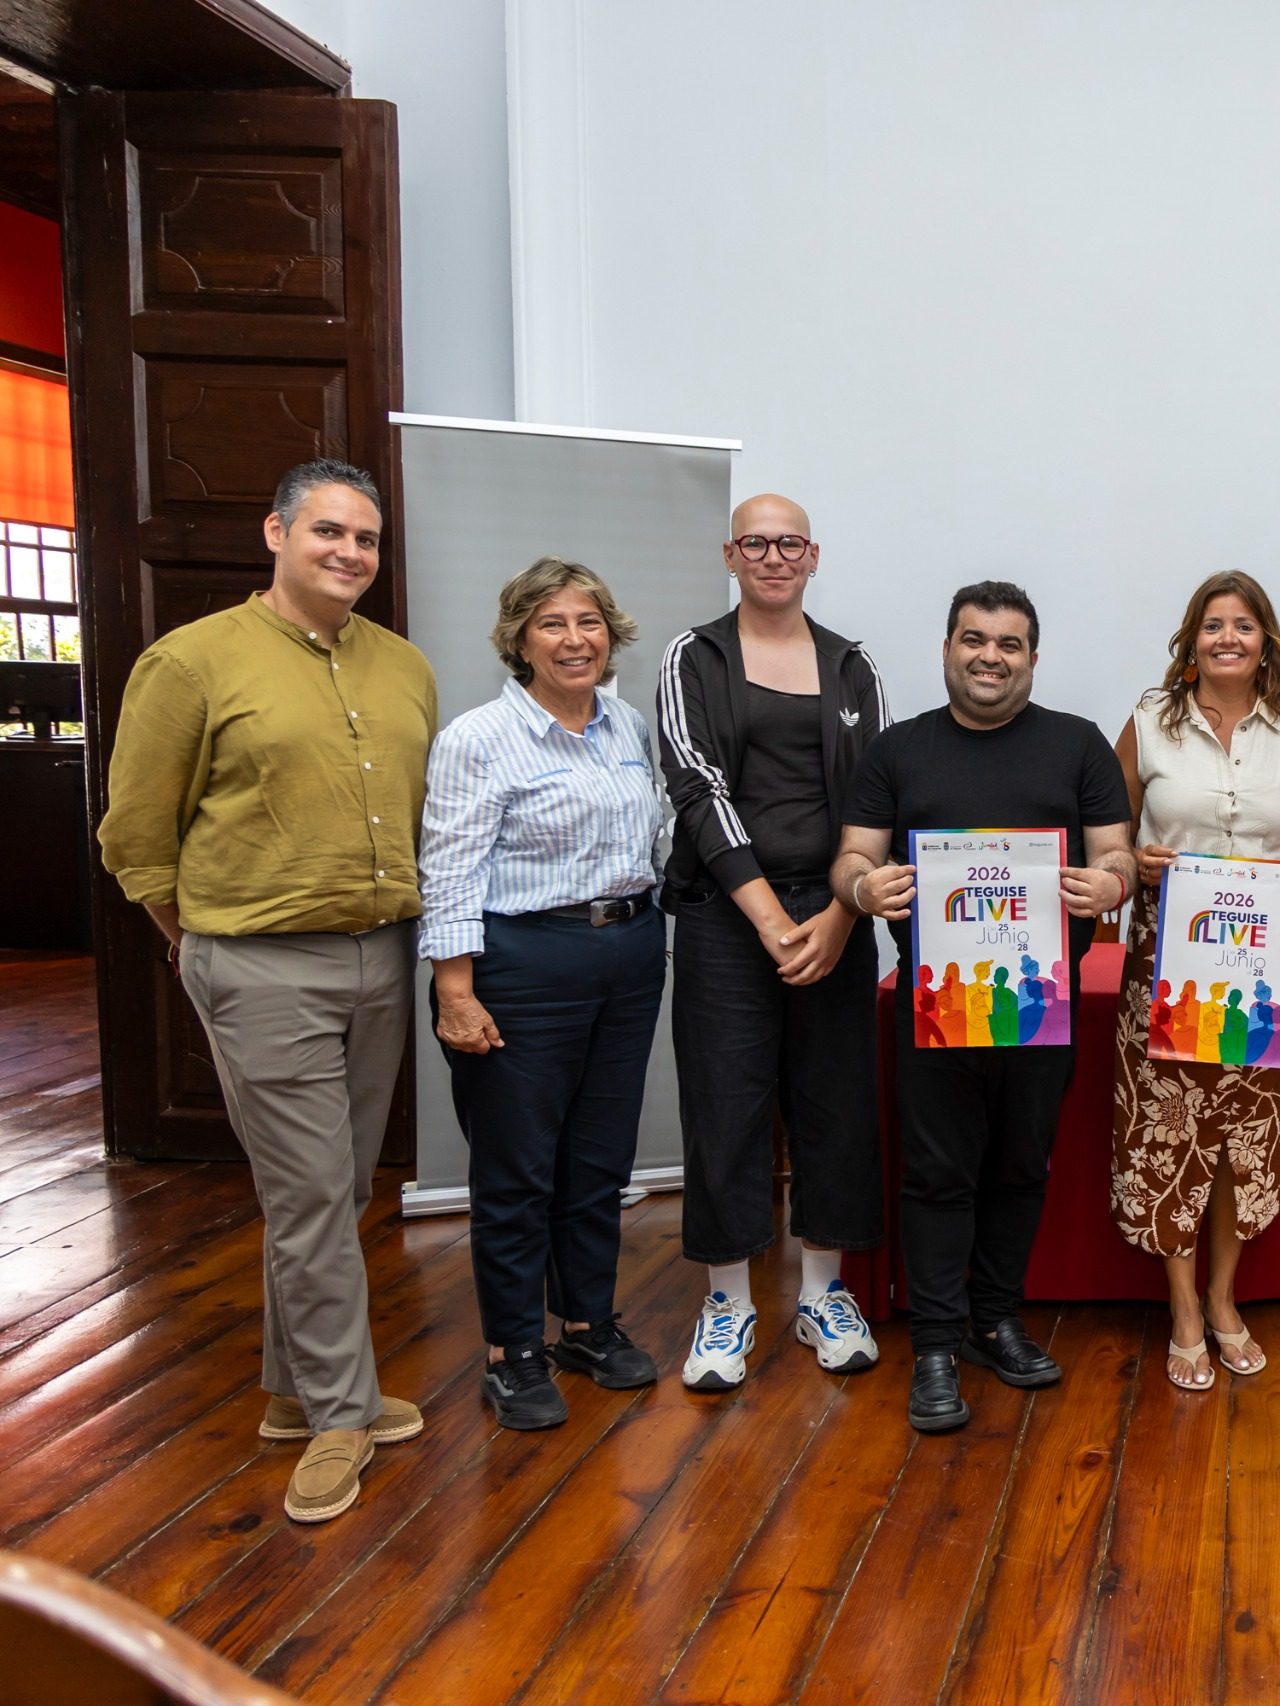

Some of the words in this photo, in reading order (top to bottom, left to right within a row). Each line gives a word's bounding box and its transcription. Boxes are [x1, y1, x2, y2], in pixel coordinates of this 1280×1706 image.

[967, 866, 1010, 881] 2026
[965, 886, 1027, 897] TEGUISE
[1213, 891, 1254, 908] 2026
[960, 898, 1028, 922] LIVE
[1209, 910, 1268, 925] TEGUISE
[976, 927, 1030, 945] Junio
[1203, 922, 1267, 947] LIVE
[1215, 950, 1265, 969] Junio
